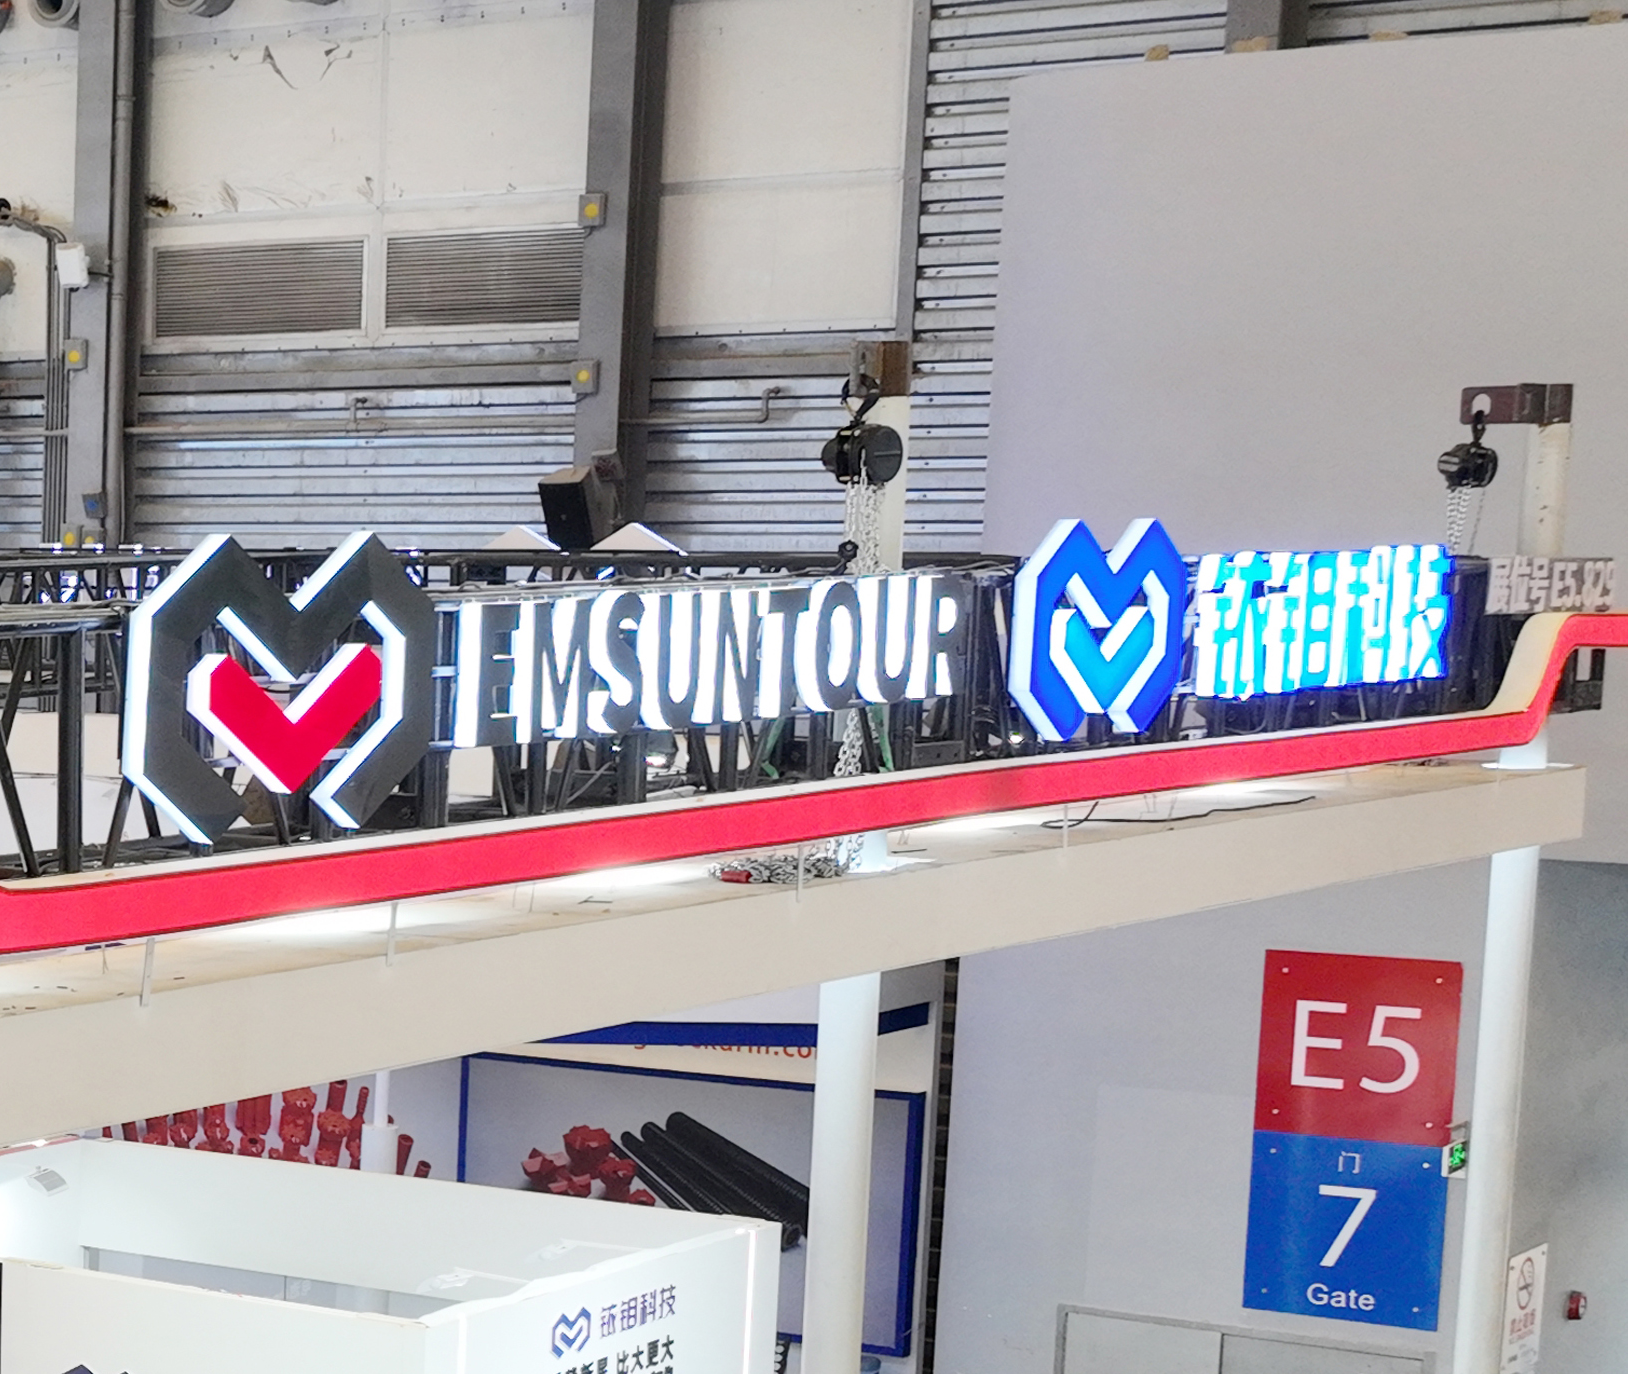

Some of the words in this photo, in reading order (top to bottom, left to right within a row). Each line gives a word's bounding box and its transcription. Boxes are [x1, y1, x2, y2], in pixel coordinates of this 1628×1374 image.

[454, 572, 975, 749] EMSUNTOUR
[1289, 998, 1423, 1095] E5
[1337, 1150, 1361, 1175] 门
[1318, 1183, 1378, 1268] 7
[1305, 1282, 1378, 1313] Gate
